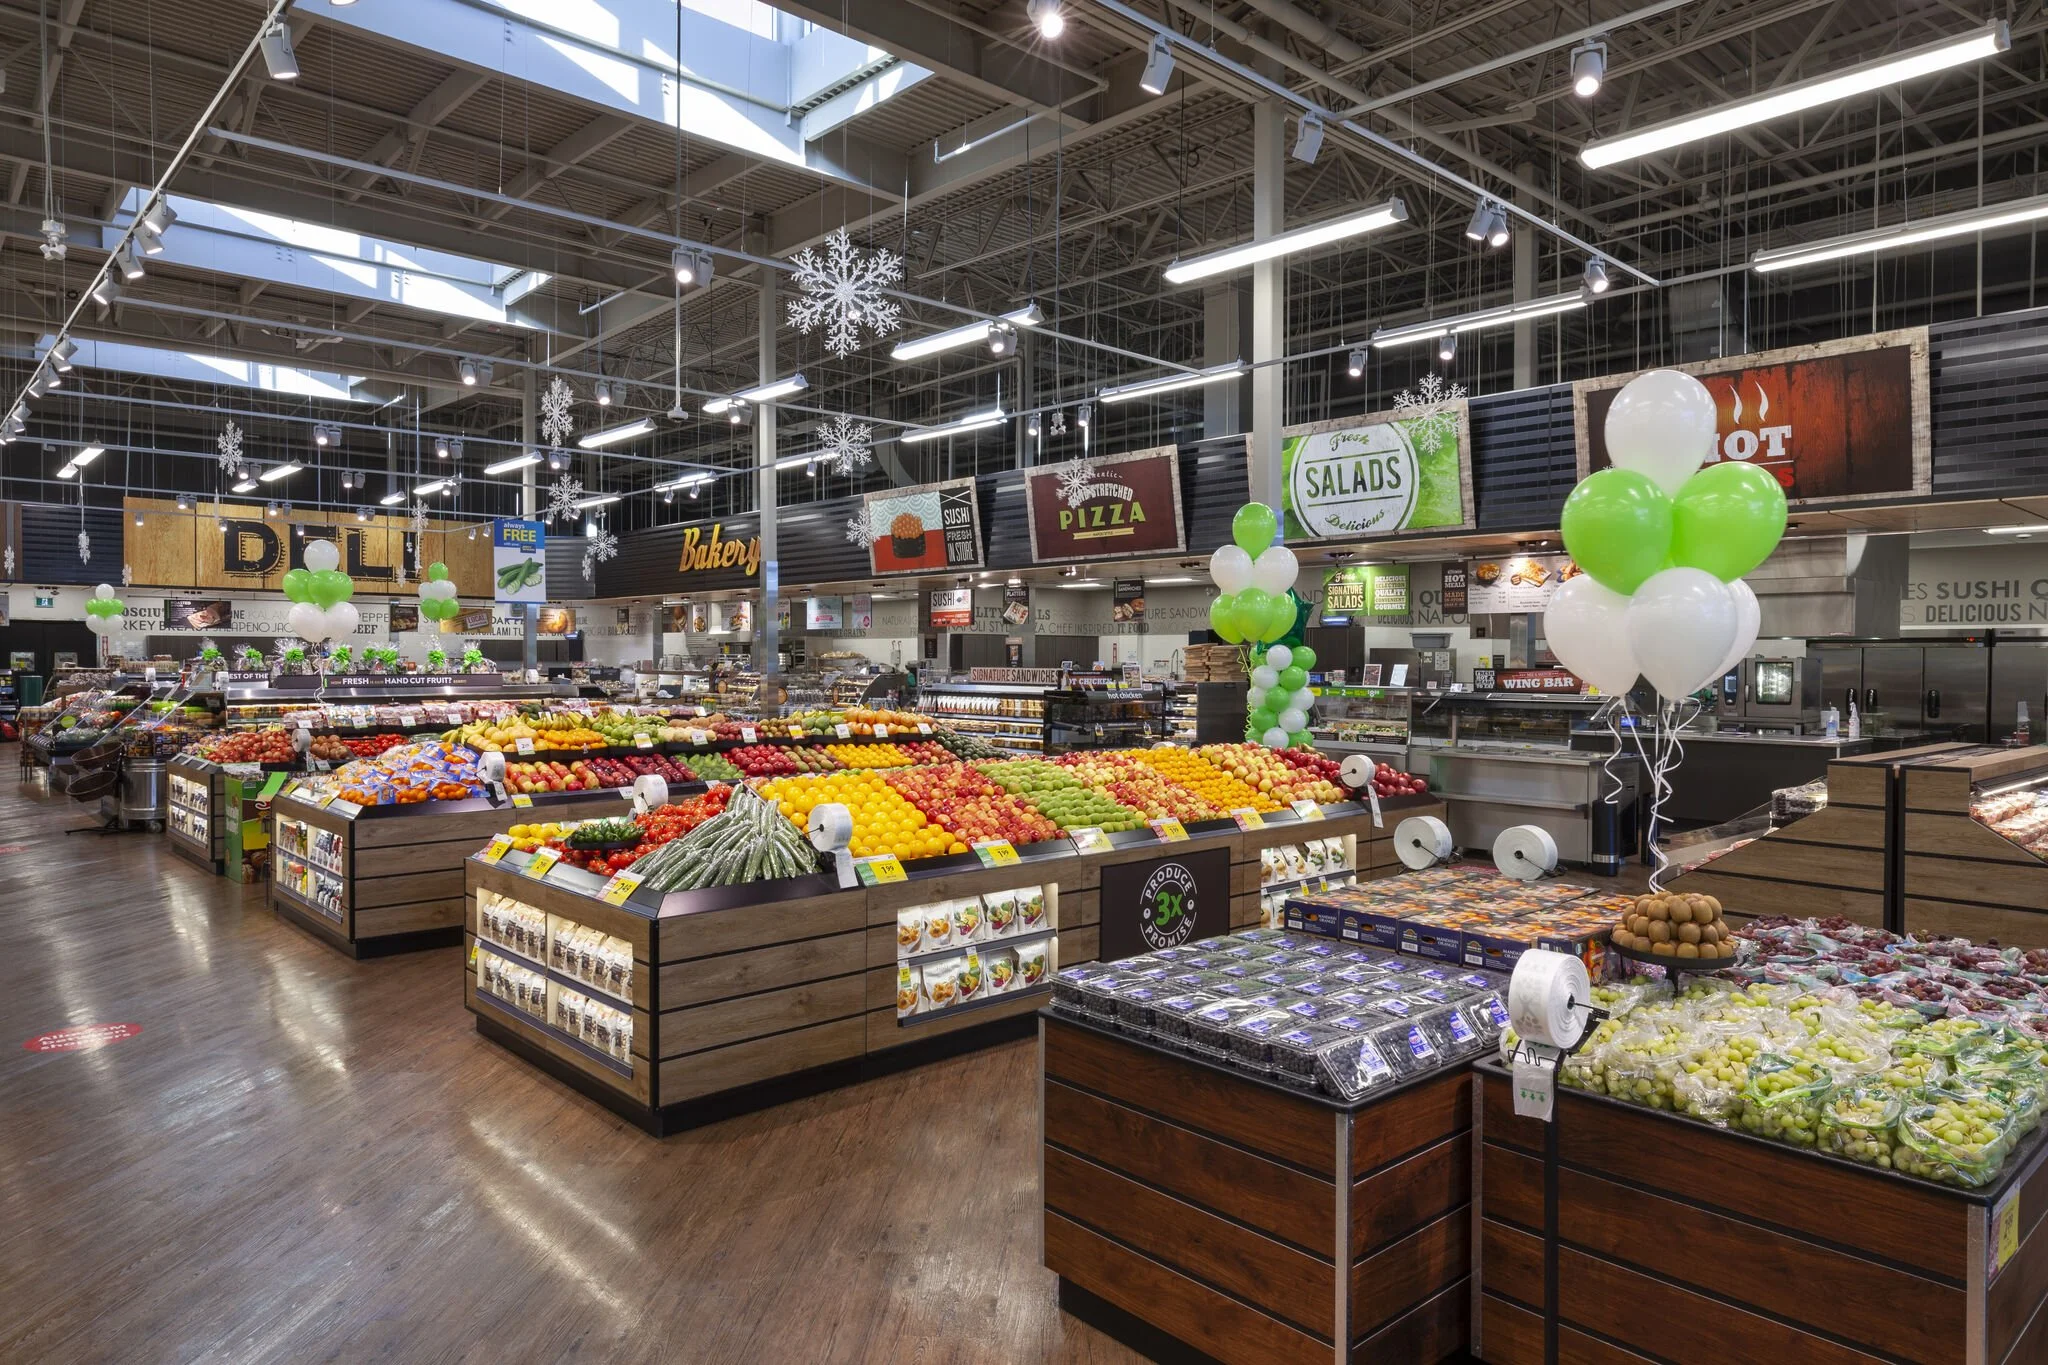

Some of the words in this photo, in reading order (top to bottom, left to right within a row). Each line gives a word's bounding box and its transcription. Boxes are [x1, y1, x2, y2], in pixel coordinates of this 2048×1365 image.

[1329, 431, 1369, 451] Fresh
[1305, 456, 1402, 498] SALADS
[1059, 501, 1146, 531] PIZZA
[1324, 508, 1385, 531] Delicious
[503, 528, 536, 542] FREE
[946, 529, 973, 542] FRESH
[679, 523, 761, 576] Bakery
[955, 541, 975, 562] STORE
[1328, 585, 1363, 595] SIGNATURE
[1936, 580, 2019, 599] SUSHI
[932, 592, 955, 606] SUSHI
[1328, 595, 1364, 609] SALADS
[466, 613, 487, 624] LOCAL
[1925, 602, 2022, 623] DELICIOUS
[1050, 623, 1073, 633] CHEF
[1074, 622, 1114, 633] INSPIRED
[1128, 622, 1149, 634] FOOD
[254, 672, 268, 680] THE
[342, 677, 369, 685] FRESH
[426, 676, 452, 684] FRUIT?
[972, 668, 1010, 682] SIGNATURE
[1011, 669, 1059, 683] SANDWICHES
[1503, 679, 1540, 689] WING
[1543, 677, 1574, 688] BAR
[1106, 691, 1120, 699] hot
[1120, 691, 1143, 699] chicken
[1144, 866, 1193, 899] PRODUCE
[1144, 916, 1192, 948] PROMISE
